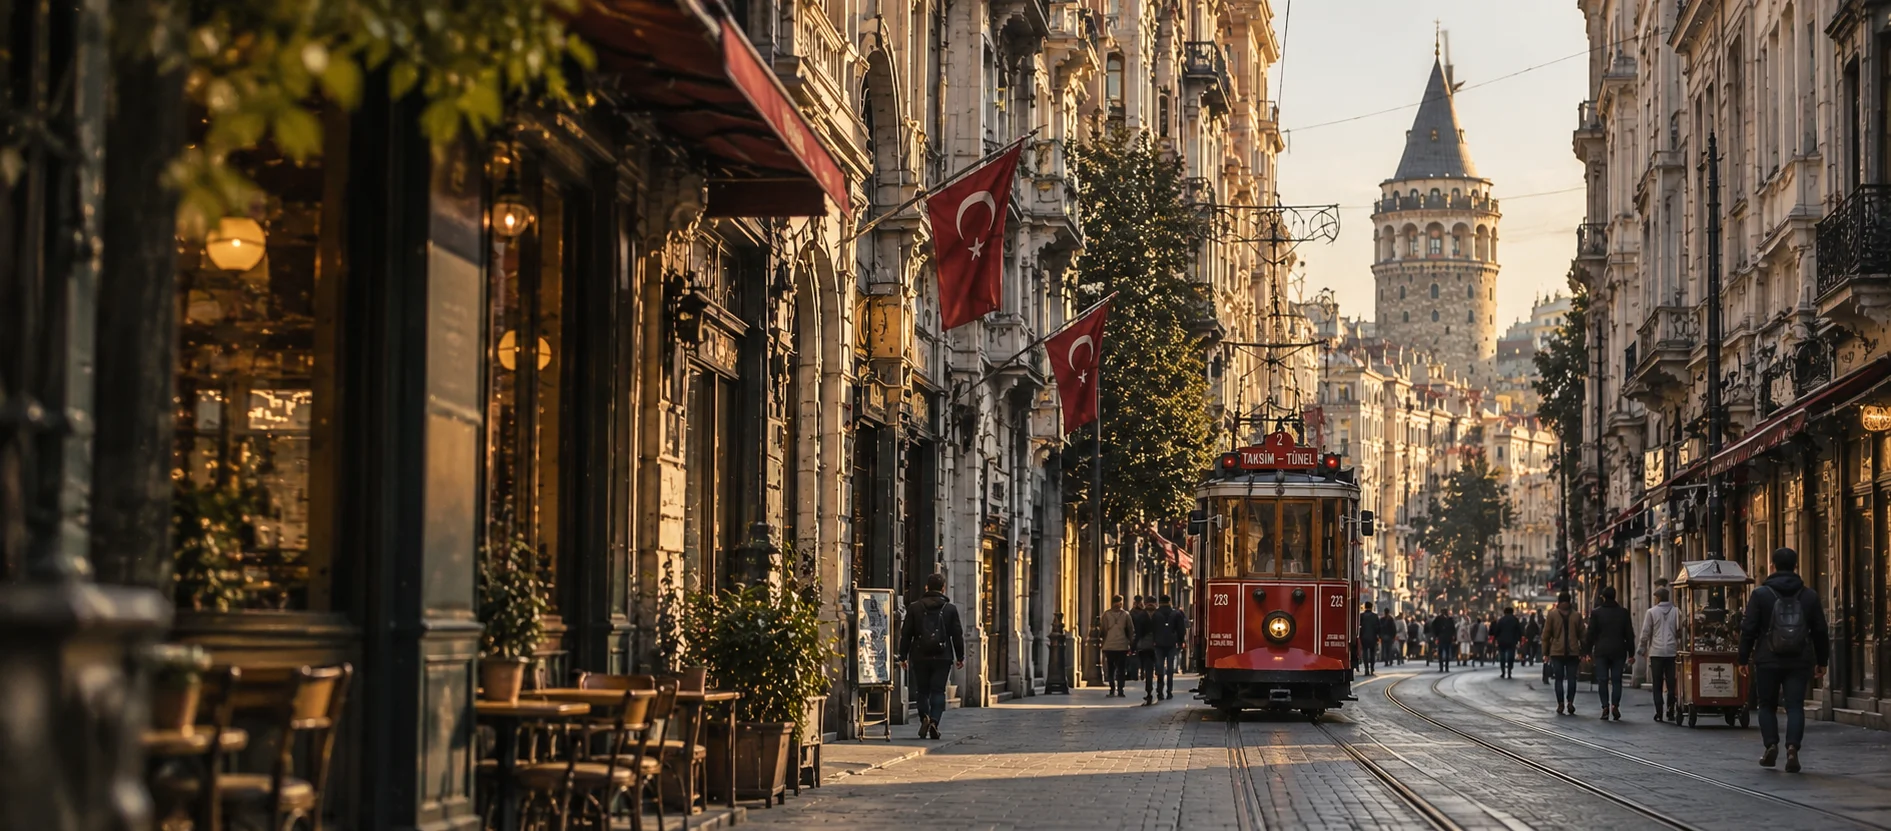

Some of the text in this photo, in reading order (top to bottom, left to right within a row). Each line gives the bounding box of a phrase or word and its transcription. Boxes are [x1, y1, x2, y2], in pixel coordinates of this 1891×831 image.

[1276, 433, 1283, 446] 2
[1241, 450, 1275, 465] TAKSİM
[1286, 450, 1314, 465] TÜNEL
[1214, 593, 1229, 606] 223
[1330, 594, 1344, 607] 223
